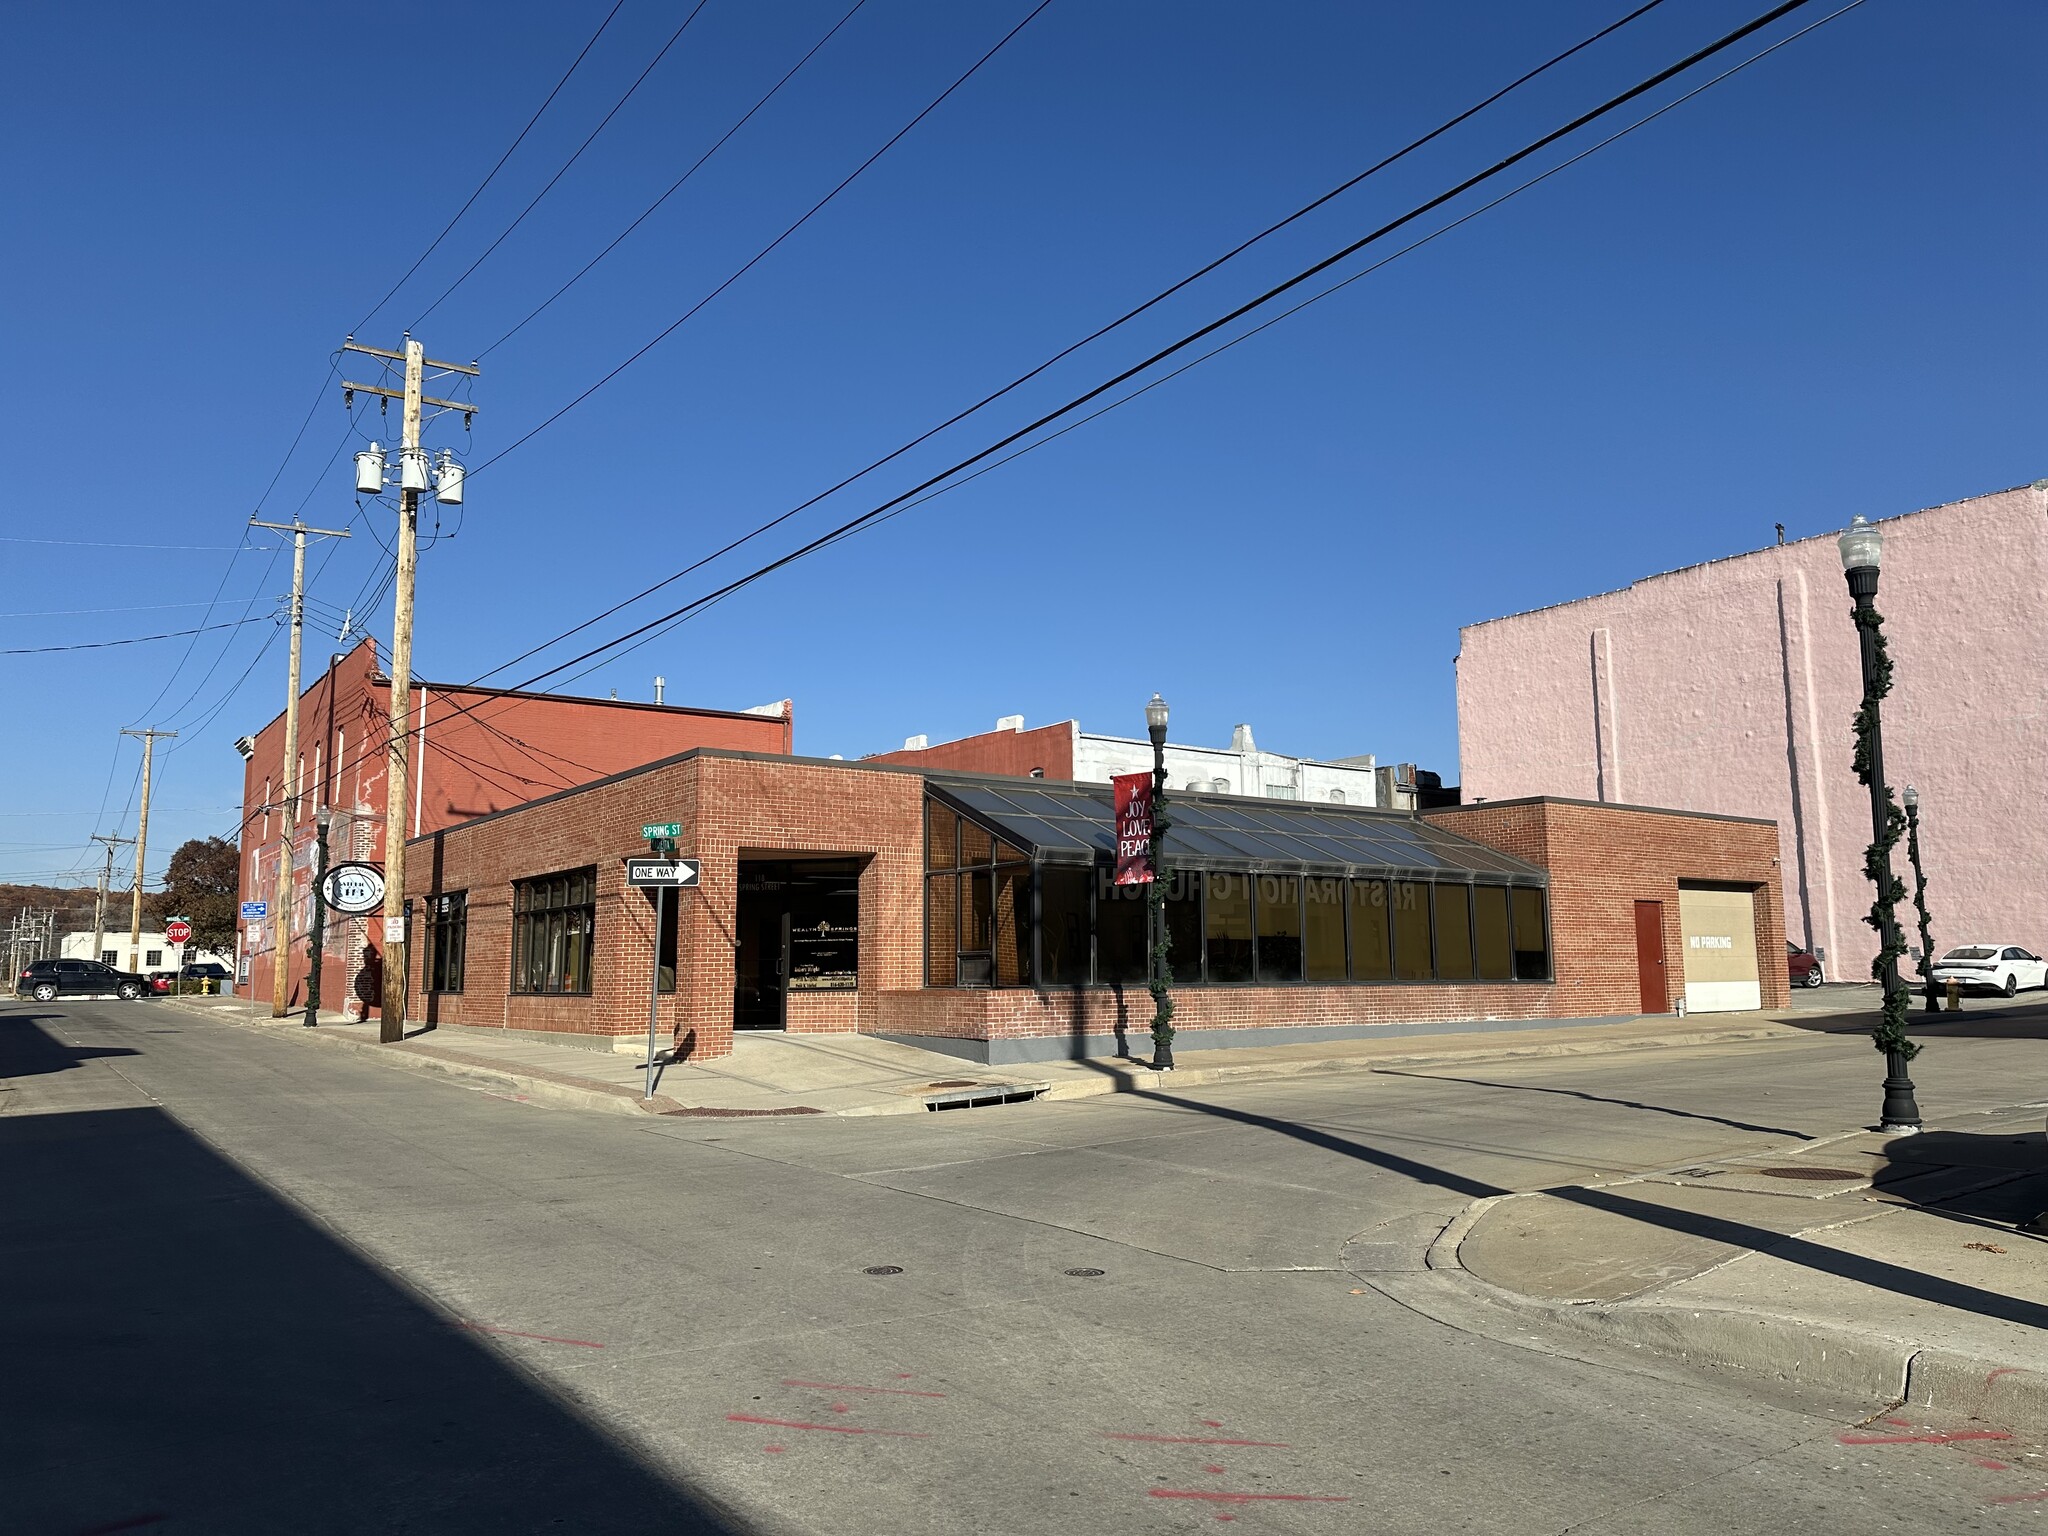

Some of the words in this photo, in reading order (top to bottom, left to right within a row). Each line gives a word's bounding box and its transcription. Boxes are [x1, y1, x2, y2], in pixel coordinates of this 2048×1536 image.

[1126, 800, 1146, 818] JOY
[643, 825, 670, 837] SPRING
[671, 824, 681, 835] ST
[1122, 819, 1151, 837] LOVE
[634, 867, 653, 878] ONE
[656, 867, 677, 878] WAY
[168, 927, 190, 937] STOP
[1689, 935, 1701, 949] NO
[1701, 936, 1732, 949] PARKING
